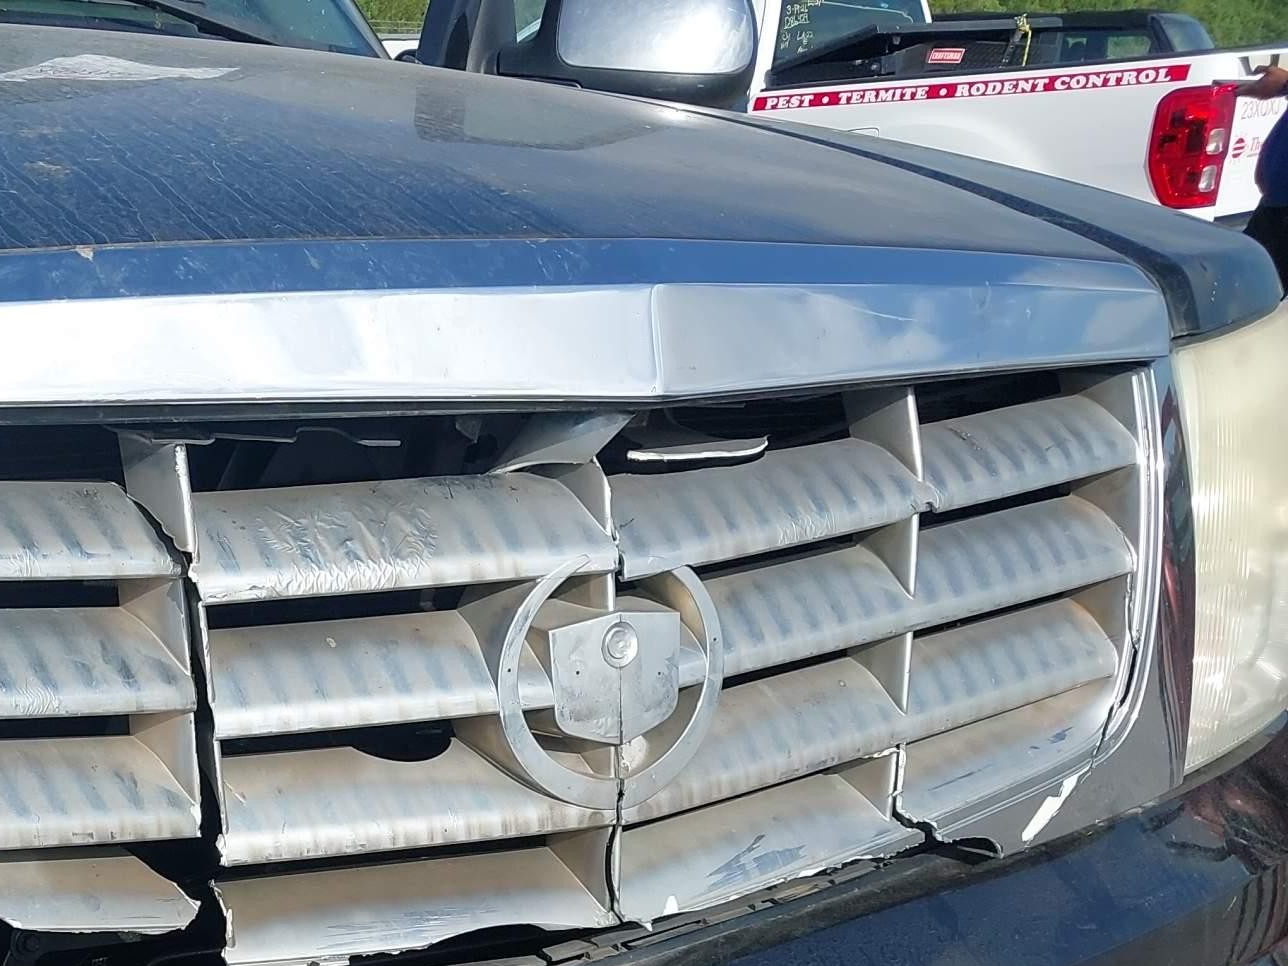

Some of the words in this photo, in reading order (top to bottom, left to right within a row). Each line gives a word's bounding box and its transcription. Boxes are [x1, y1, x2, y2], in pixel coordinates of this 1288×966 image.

[765, 95, 813, 109] PEST
[838, 87, 928, 104] TERMITE
[955, 78, 1049, 97] RODENT
[1055, 68, 1171, 90] CONTROL
